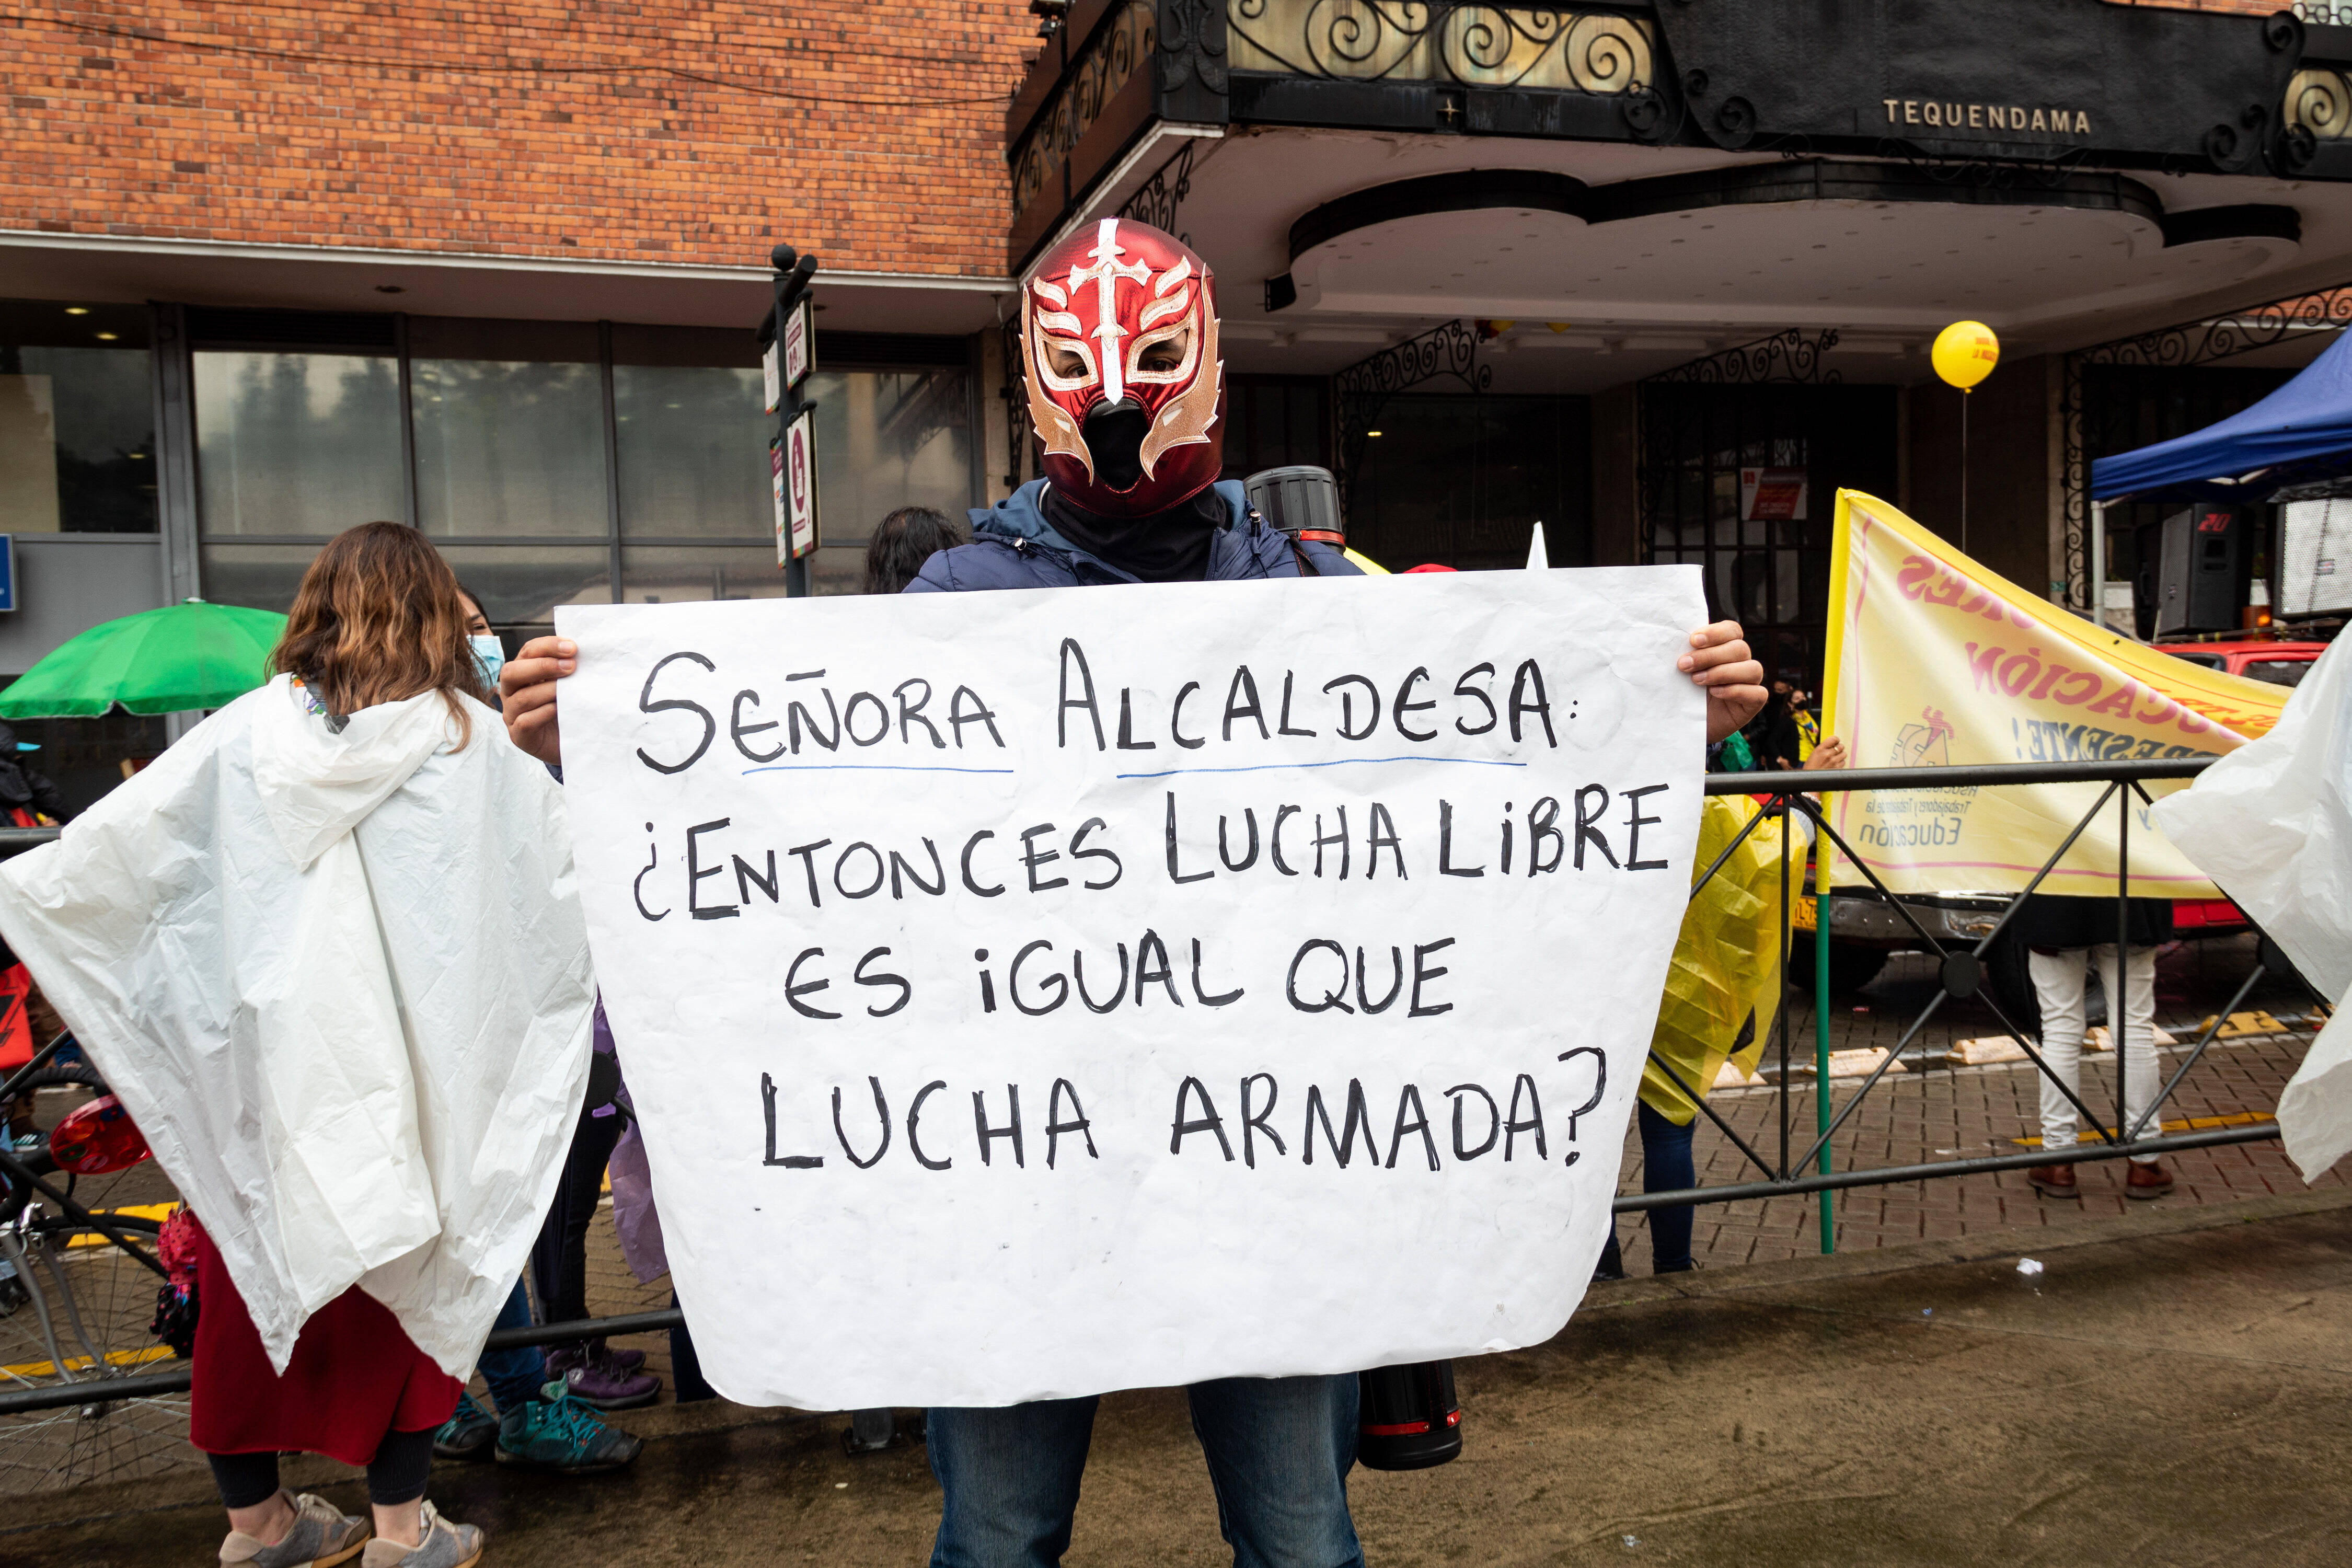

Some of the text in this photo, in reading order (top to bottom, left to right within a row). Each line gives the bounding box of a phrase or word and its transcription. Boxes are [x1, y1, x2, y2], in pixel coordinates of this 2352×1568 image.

[1883, 99, 2091, 134] TEQUENDAMA
[636, 637, 1578, 775] SEÑORA ALCALDESA:
[633, 816, 1123, 922] ¿ENTONCES
[1165, 790, 1409, 885] LUCHA
[784, 946, 912, 1020] ES
[1286, 937, 1456, 1019] QUE
[760, 1046, 1607, 1172] LUCHA ARMADA?
